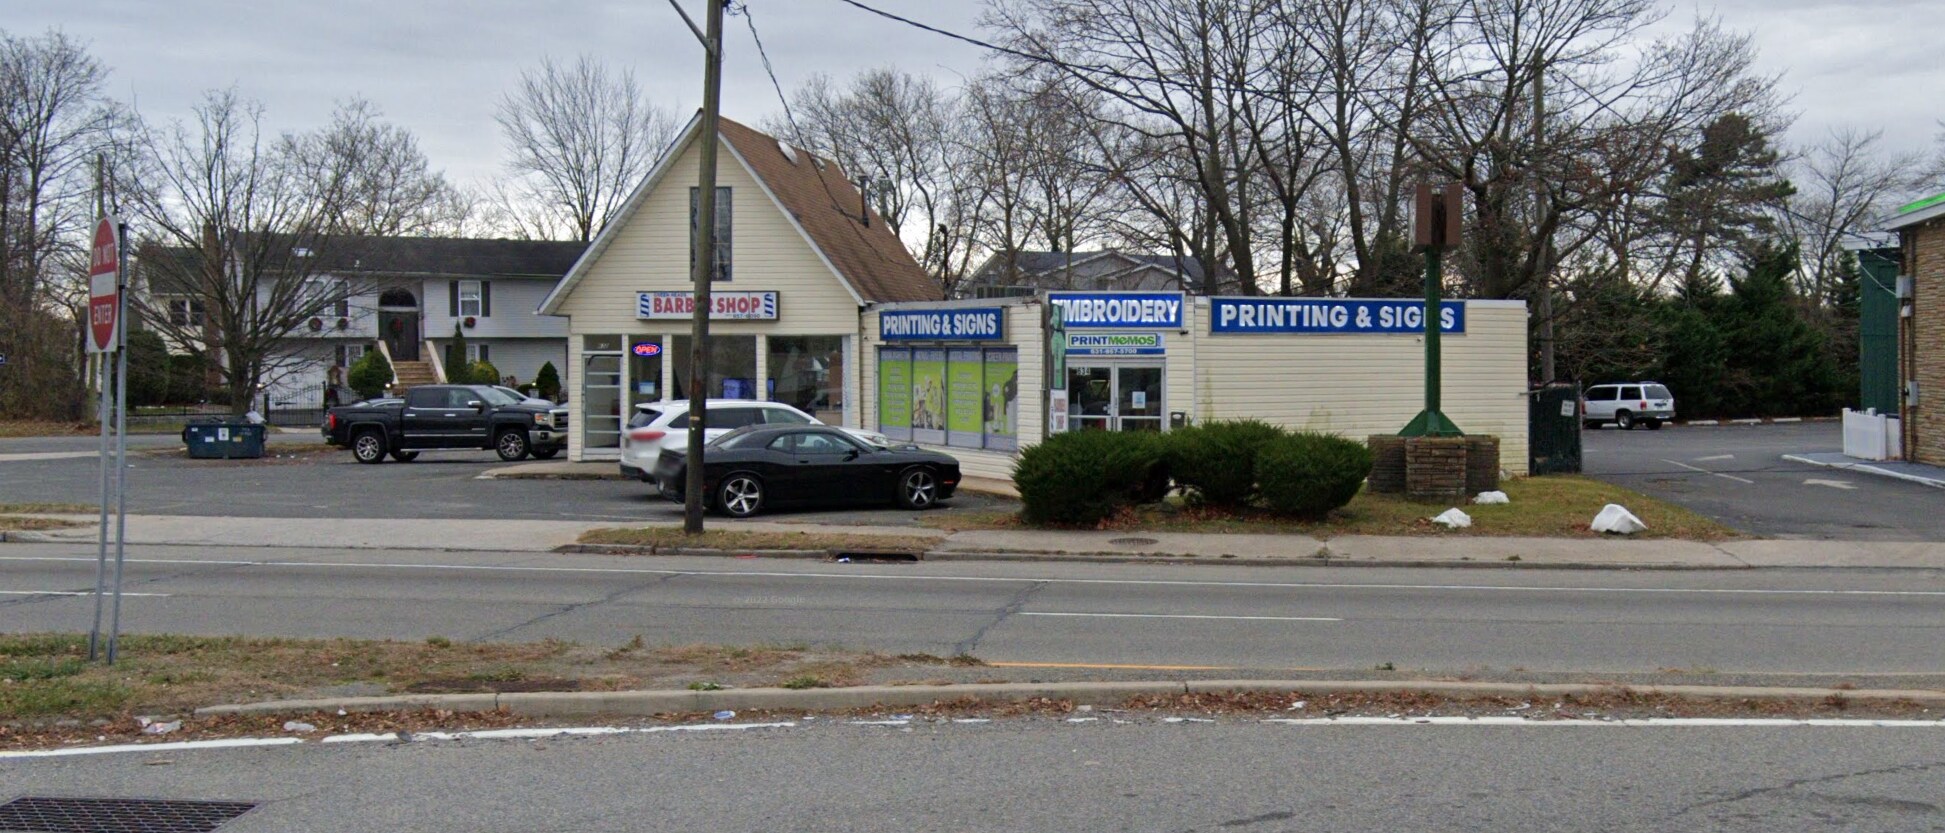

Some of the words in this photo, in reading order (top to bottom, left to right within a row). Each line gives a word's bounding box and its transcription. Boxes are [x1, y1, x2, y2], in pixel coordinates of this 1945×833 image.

[94, 303, 112, 325] ENTER
[717, 297, 761, 313] SHOP
[883, 314, 941, 335] PRINTING
[942, 314, 952, 335] &
[953, 313, 996, 335] SIGNS
[1220, 304, 1349, 327] PRINTING
[1356, 306, 1373, 328] &
[1379, 305, 1456, 329] SIGS
[635, 345, 658, 354] OPEN
